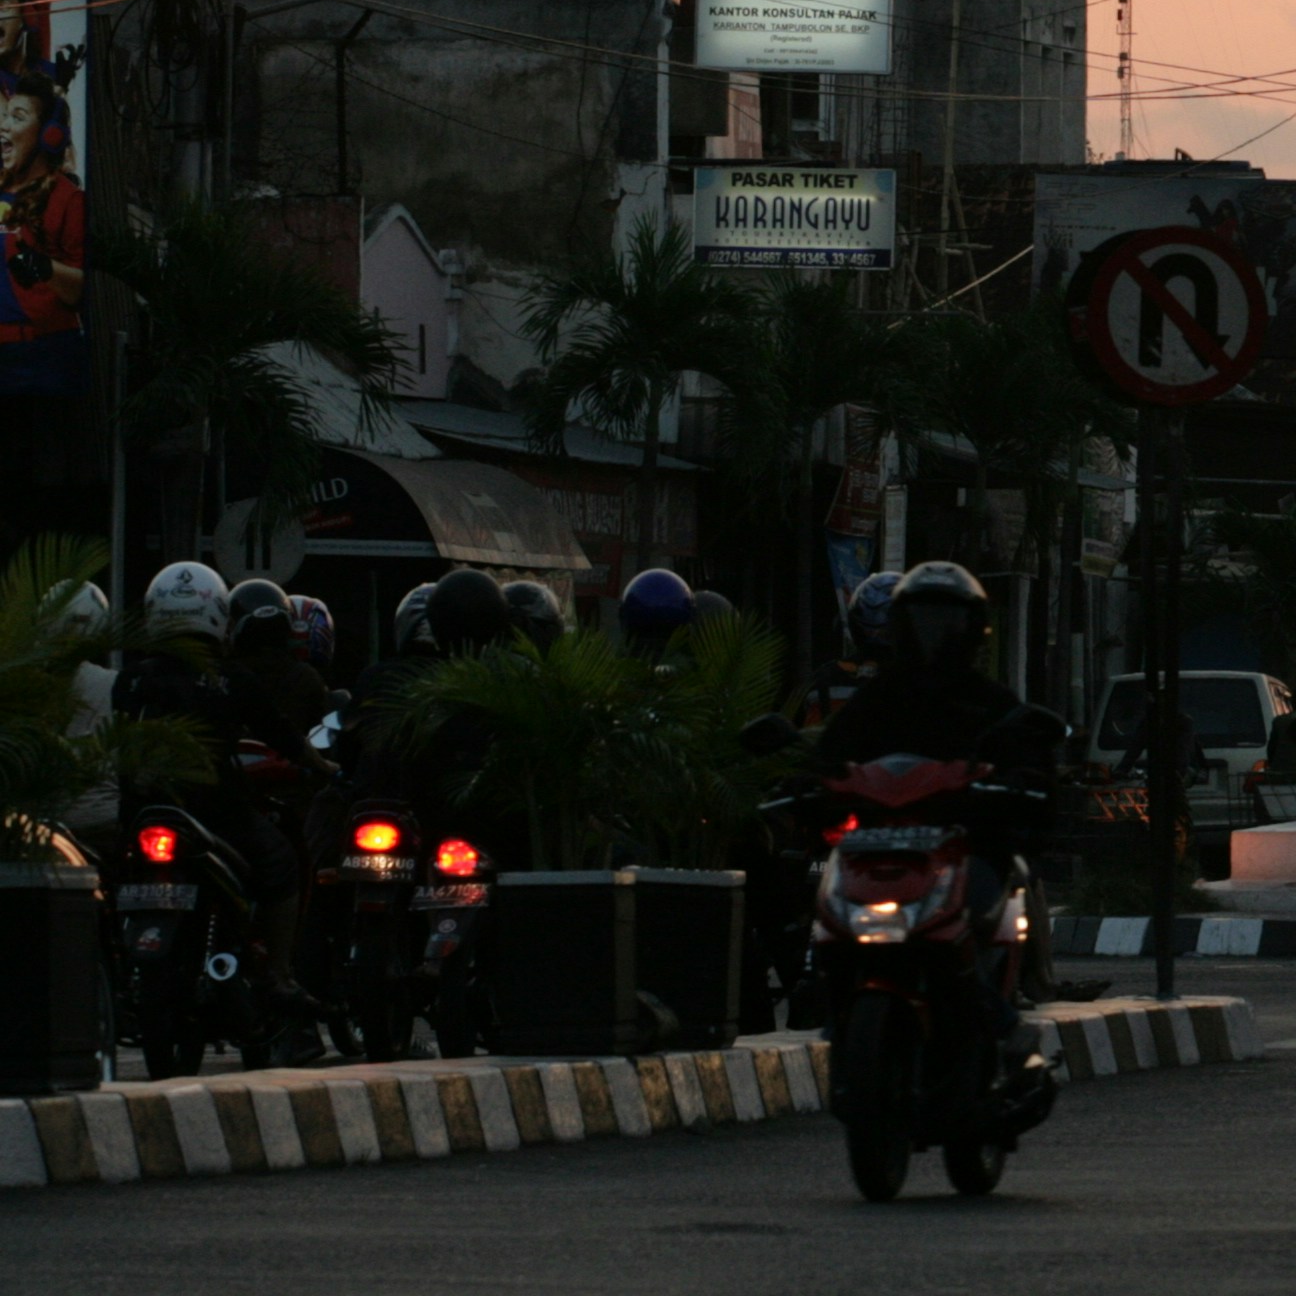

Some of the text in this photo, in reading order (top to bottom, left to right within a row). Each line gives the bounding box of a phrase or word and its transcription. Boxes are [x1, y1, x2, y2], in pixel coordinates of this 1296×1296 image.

[709, 6, 877, 20] KANTOR KONSULTAN PAJAK
[772, 23, 832, 32] TAMPUBOLON
[732, 172, 858, 188] PASAR TIKET
[715, 195, 870, 231] KARANGAYU
